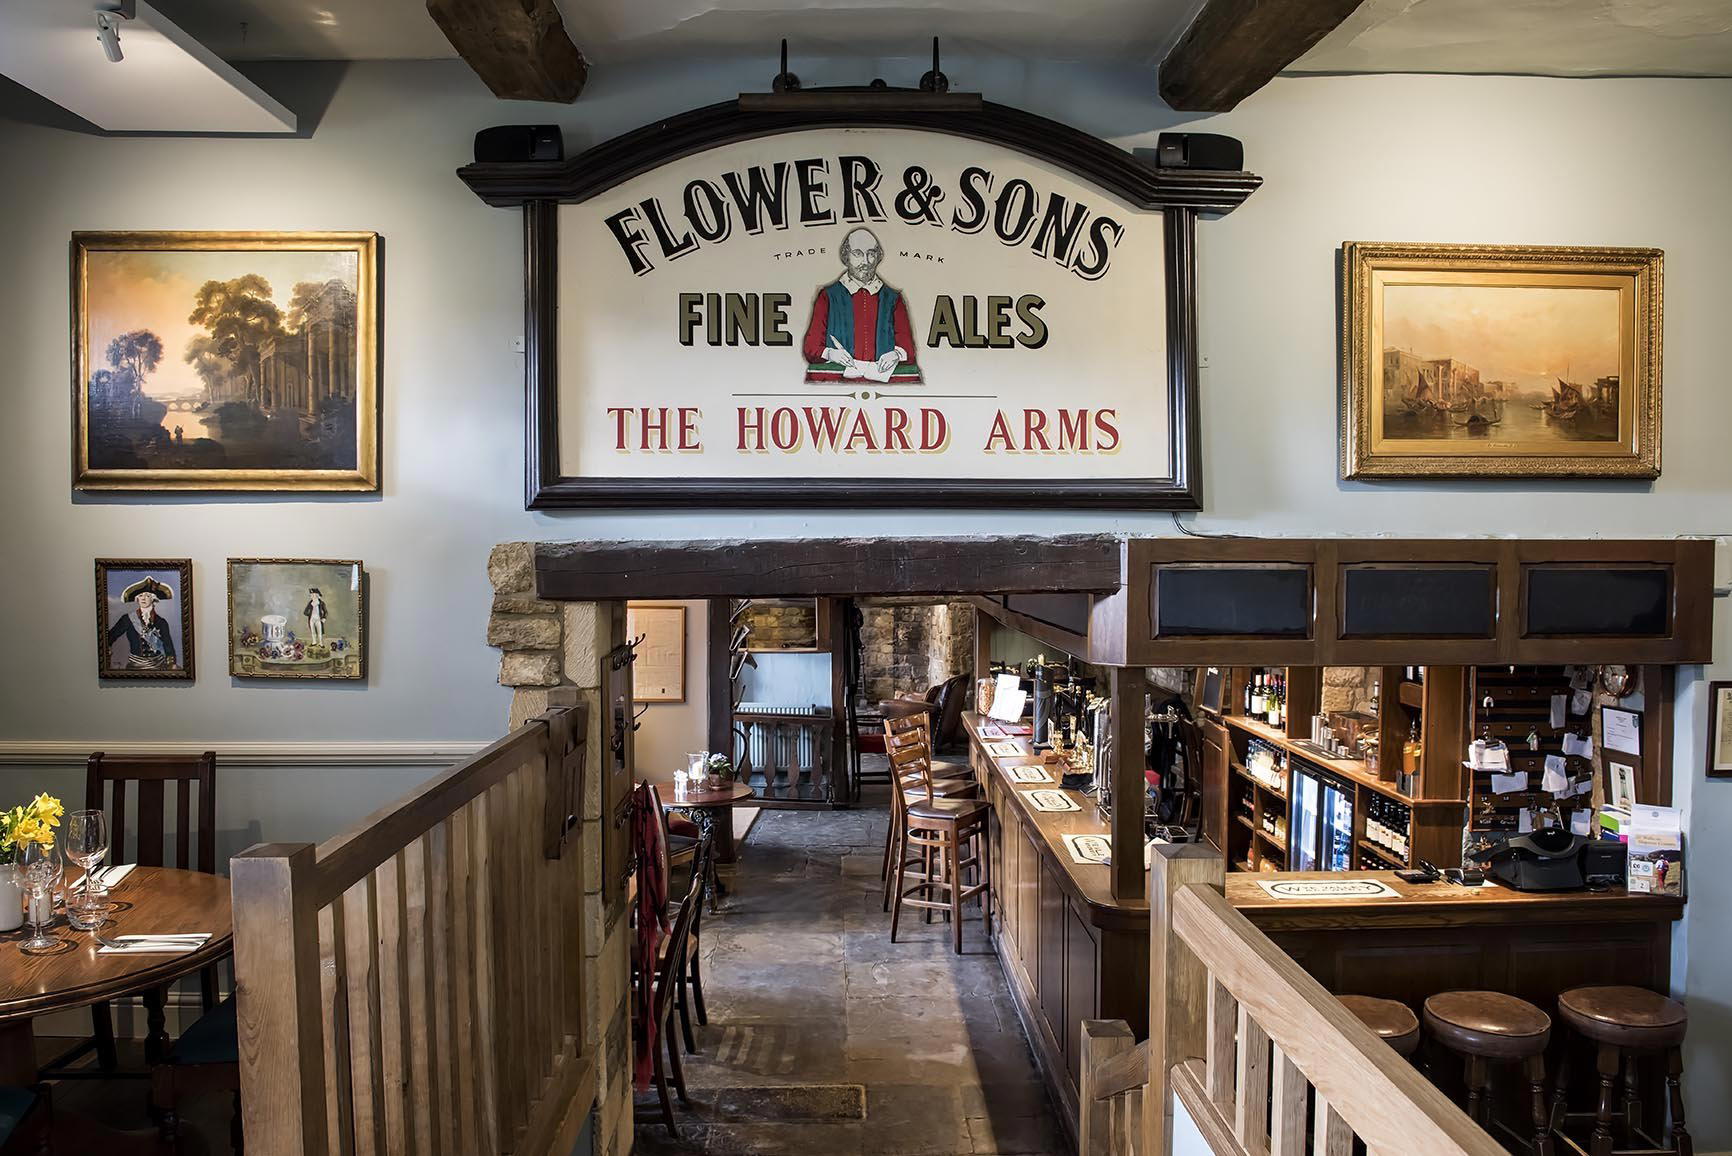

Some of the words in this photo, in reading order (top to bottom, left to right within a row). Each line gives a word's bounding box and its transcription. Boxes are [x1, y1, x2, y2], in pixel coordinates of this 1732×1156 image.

[604, 155, 886, 281] FLOWER
[893, 165, 945, 226] &
[951, 166, 1126, 281] SONS
[773, 246, 827, 262] TRADE
[898, 250, 946, 264] MARK
[679, 292, 793, 347] FINE
[926, 293, 1049, 349] ALES
[607, 406, 704, 455] THE
[736, 406, 952, 455] HOWARD
[983, 407, 1123, 455] ARMS
